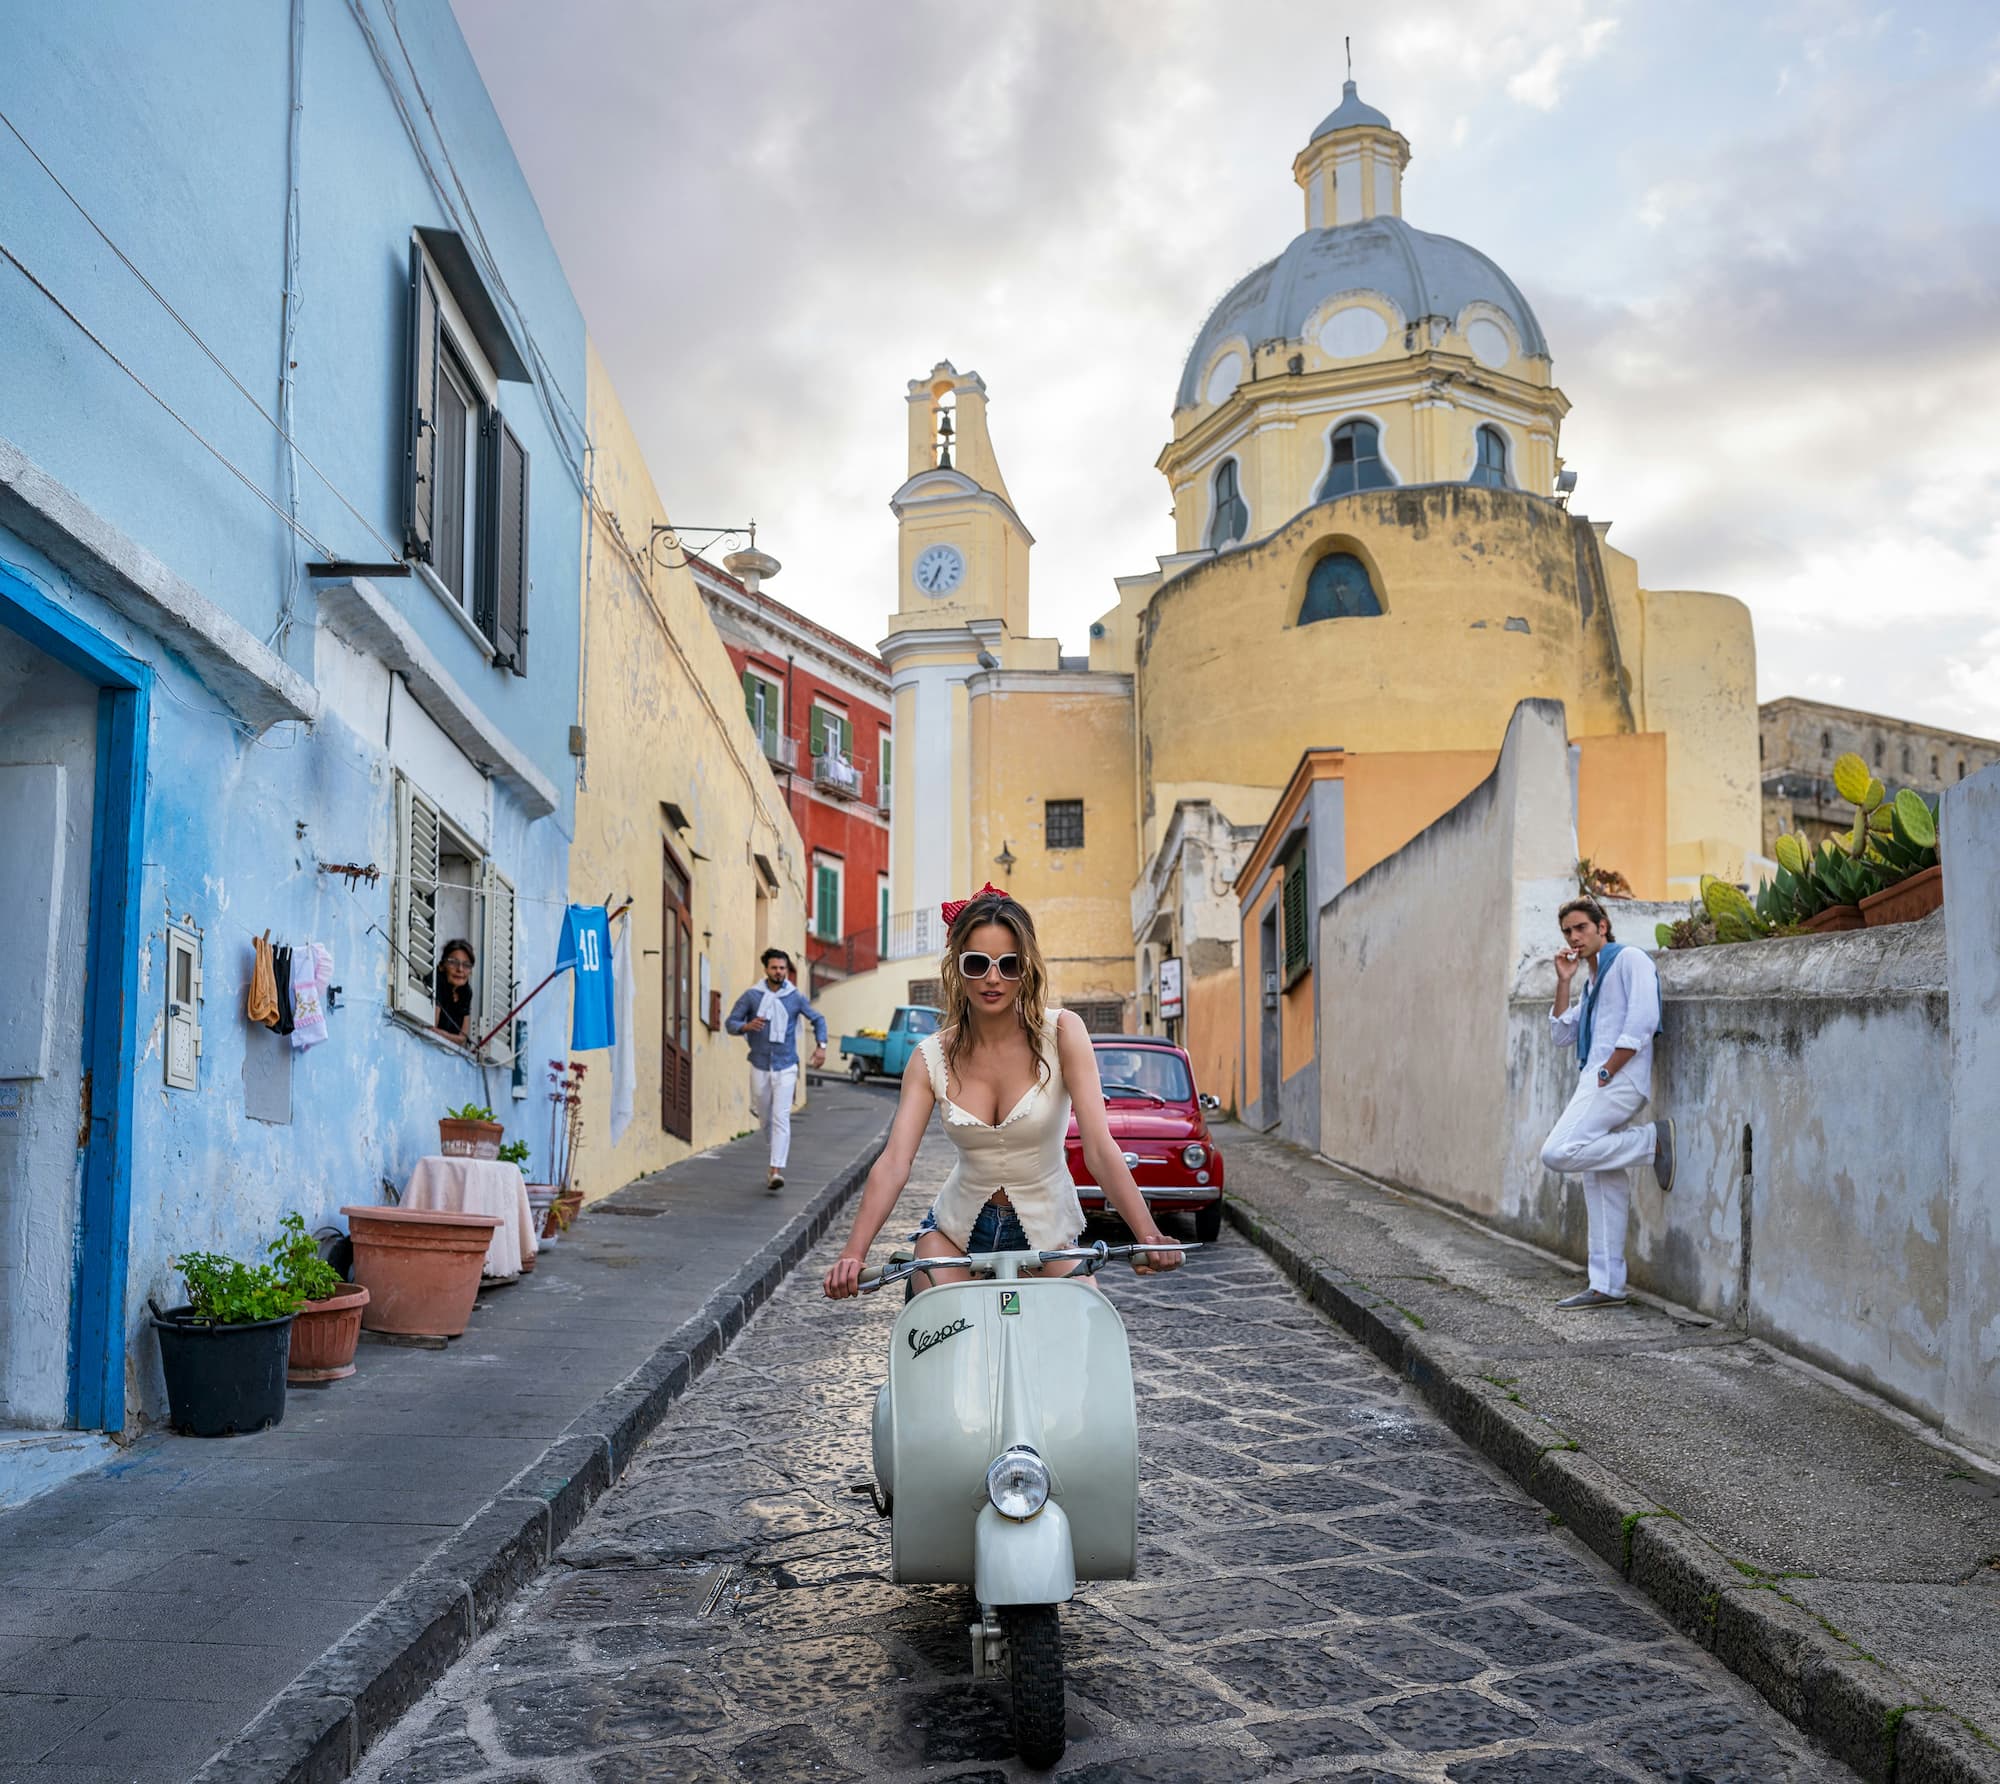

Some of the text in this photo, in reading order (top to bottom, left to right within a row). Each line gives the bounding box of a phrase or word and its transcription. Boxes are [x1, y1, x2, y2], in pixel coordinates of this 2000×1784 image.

[579, 928, 600, 971] 10
[1002, 1292, 1012, 1306] P
[908, 1318, 975, 1360] Vespa
